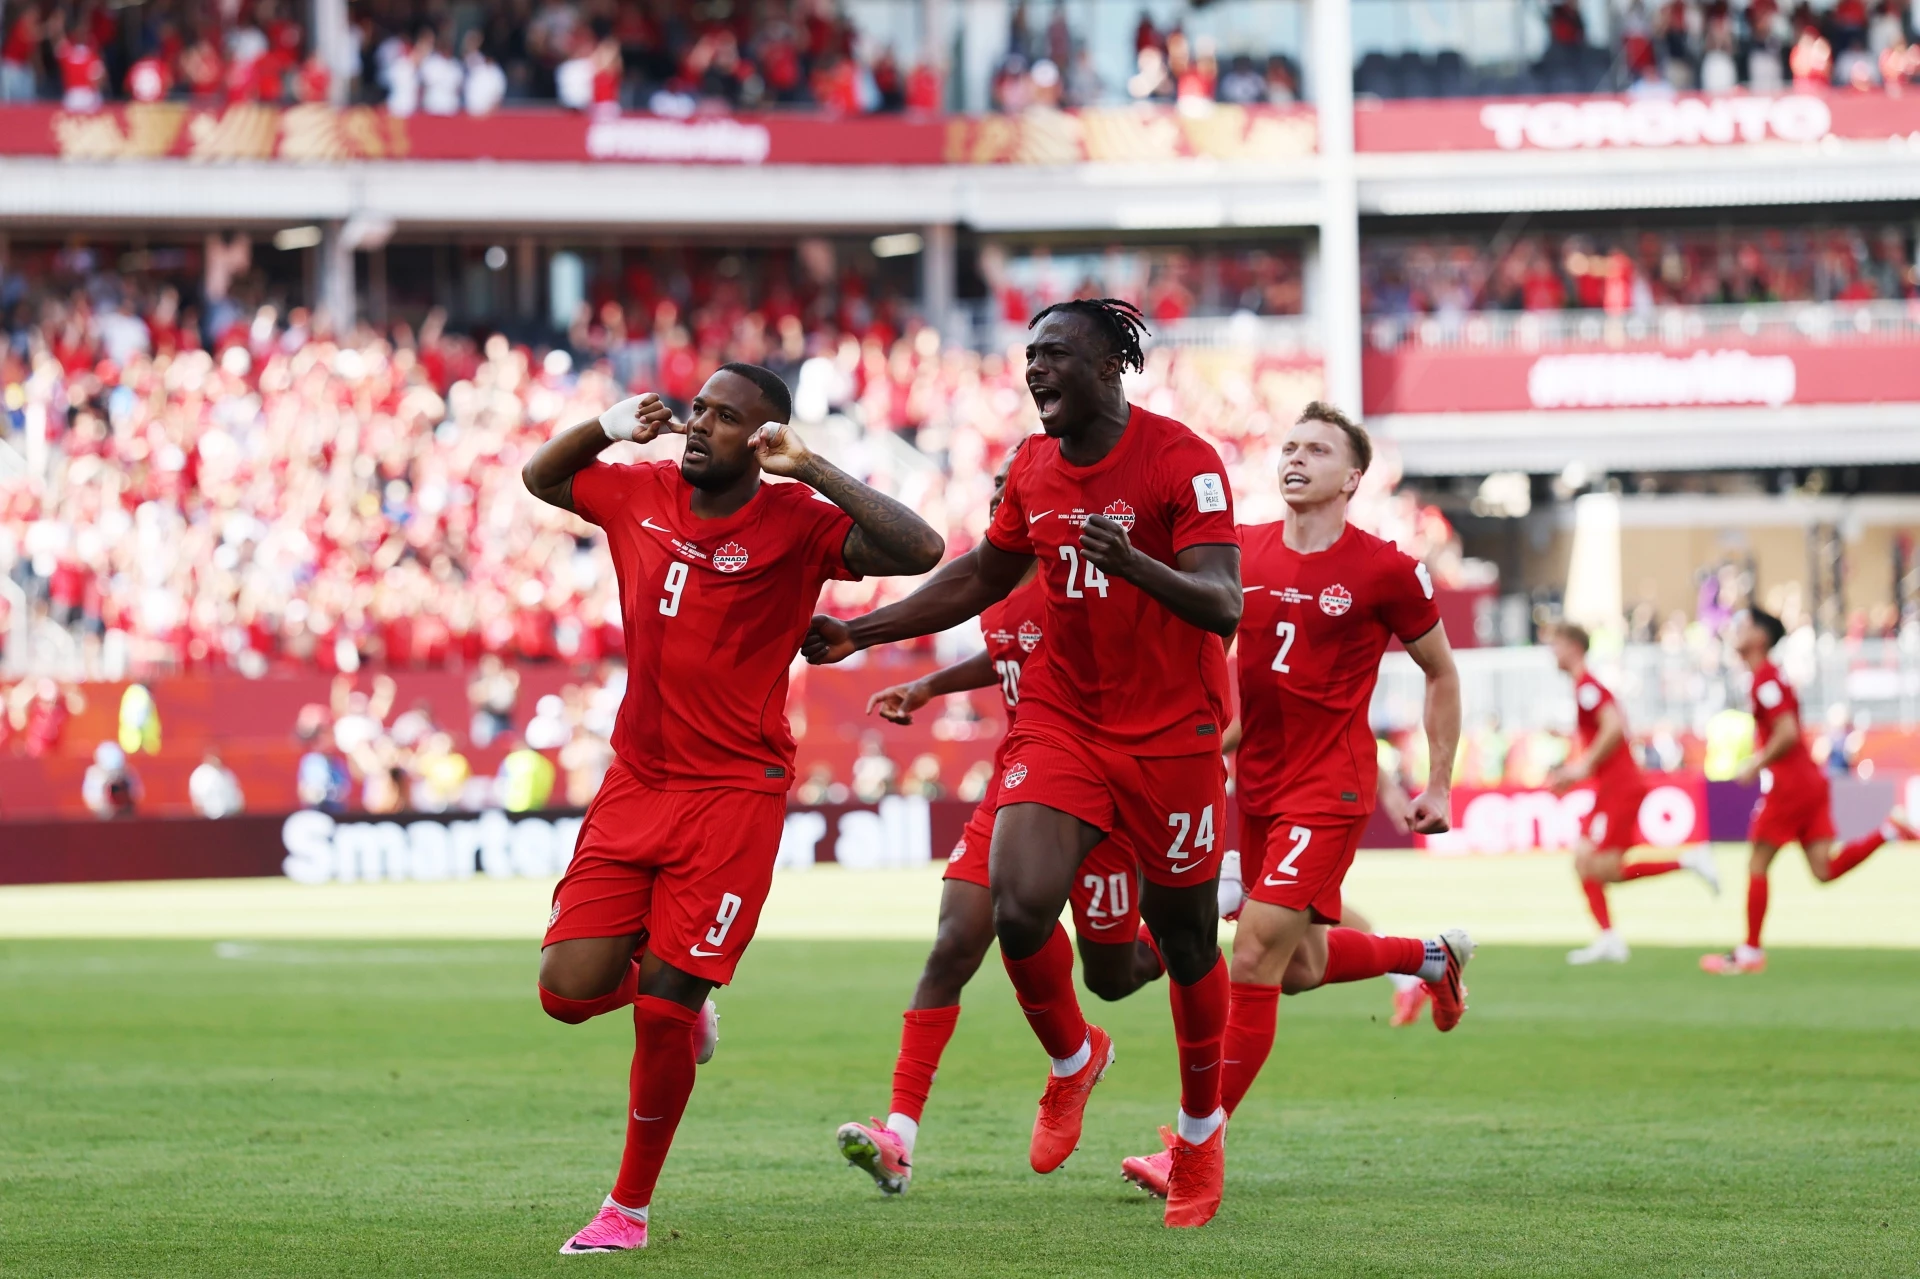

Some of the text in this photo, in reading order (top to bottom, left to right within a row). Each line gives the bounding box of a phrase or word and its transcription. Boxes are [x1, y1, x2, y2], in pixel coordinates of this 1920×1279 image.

[1480, 96, 1831, 149] TORONTO
[659, 561, 689, 617] 9
[1058, 545, 1110, 599] 24
[1271, 621, 1296, 674] 2
[996, 660, 1021, 706] 20
[281, 809, 588, 884] Smarter
[833, 794, 933, 872] all
[1166, 803, 1215, 859] 24
[1277, 826, 1313, 877] 2
[705, 892, 742, 947] 9
[1083, 871, 1129, 918] 20
